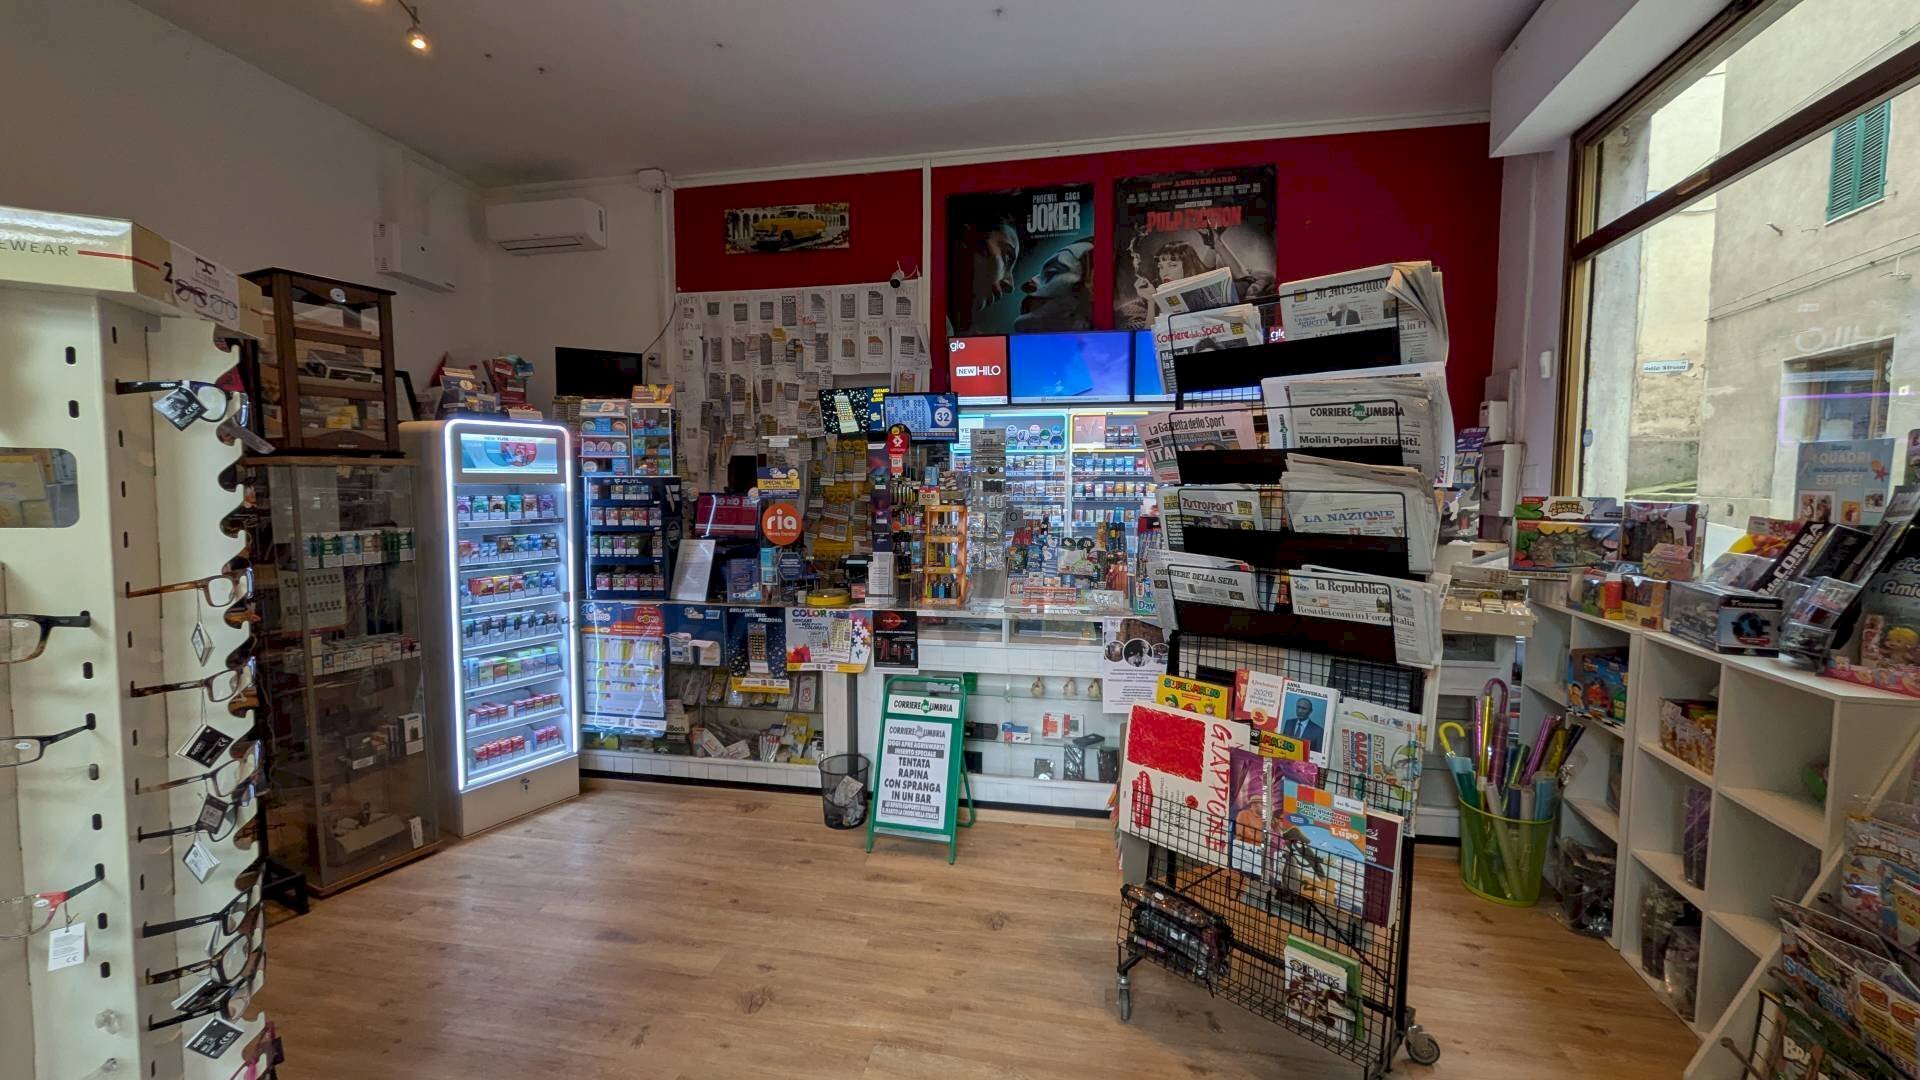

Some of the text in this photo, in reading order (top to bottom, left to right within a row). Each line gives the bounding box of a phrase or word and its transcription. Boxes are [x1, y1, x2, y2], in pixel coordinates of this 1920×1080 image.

[1027, 202, 1080, 233] JOKER
[1147, 205, 1242, 233] PULP FICTION
[950, 341, 965, 352] glo
[977, 365, 1001, 376] HILO
[937, 412, 950, 422] 32
[1310, 407, 1352, 417] CORRIERE
[1367, 407, 1405, 417] UMBRIA
[1149, 415, 1226, 435] La Gazzetta dello Sport
[1299, 436, 1421, 447] Molini Popolari Riuniti.
[767, 509, 796, 529] ria
[1327, 511, 1395, 521] NAZIONE
[1774, 524, 1824, 578] CORSA
[1155, 568, 1239, 586] CORRIERE DELLA SERA
[1315, 580, 1325, 590] la
[1328, 580, 1388, 595] Repubblica
[792, 609, 827, 618] COLOR
[1365, 613, 1391, 622] Forza
[1392, 616, 1415, 626] Italia
[1164, 678, 1221, 698] SUPER MARIO
[894, 700, 952, 712] CORRIERE UMBRIA
[889, 726, 945, 738] CORRIERE UMBRIA
[1262, 733, 1296, 752] MARIO
[899, 757, 930, 768] TENTATA
[899, 768, 928, 780] RAPINA
[884, 779, 941, 793] CON SPRANGA
[1206, 723, 1233, 854] GIAPPONE
[891, 791, 931, 804] IN UN BAR
[1331, 827, 1359, 840] Lupo
